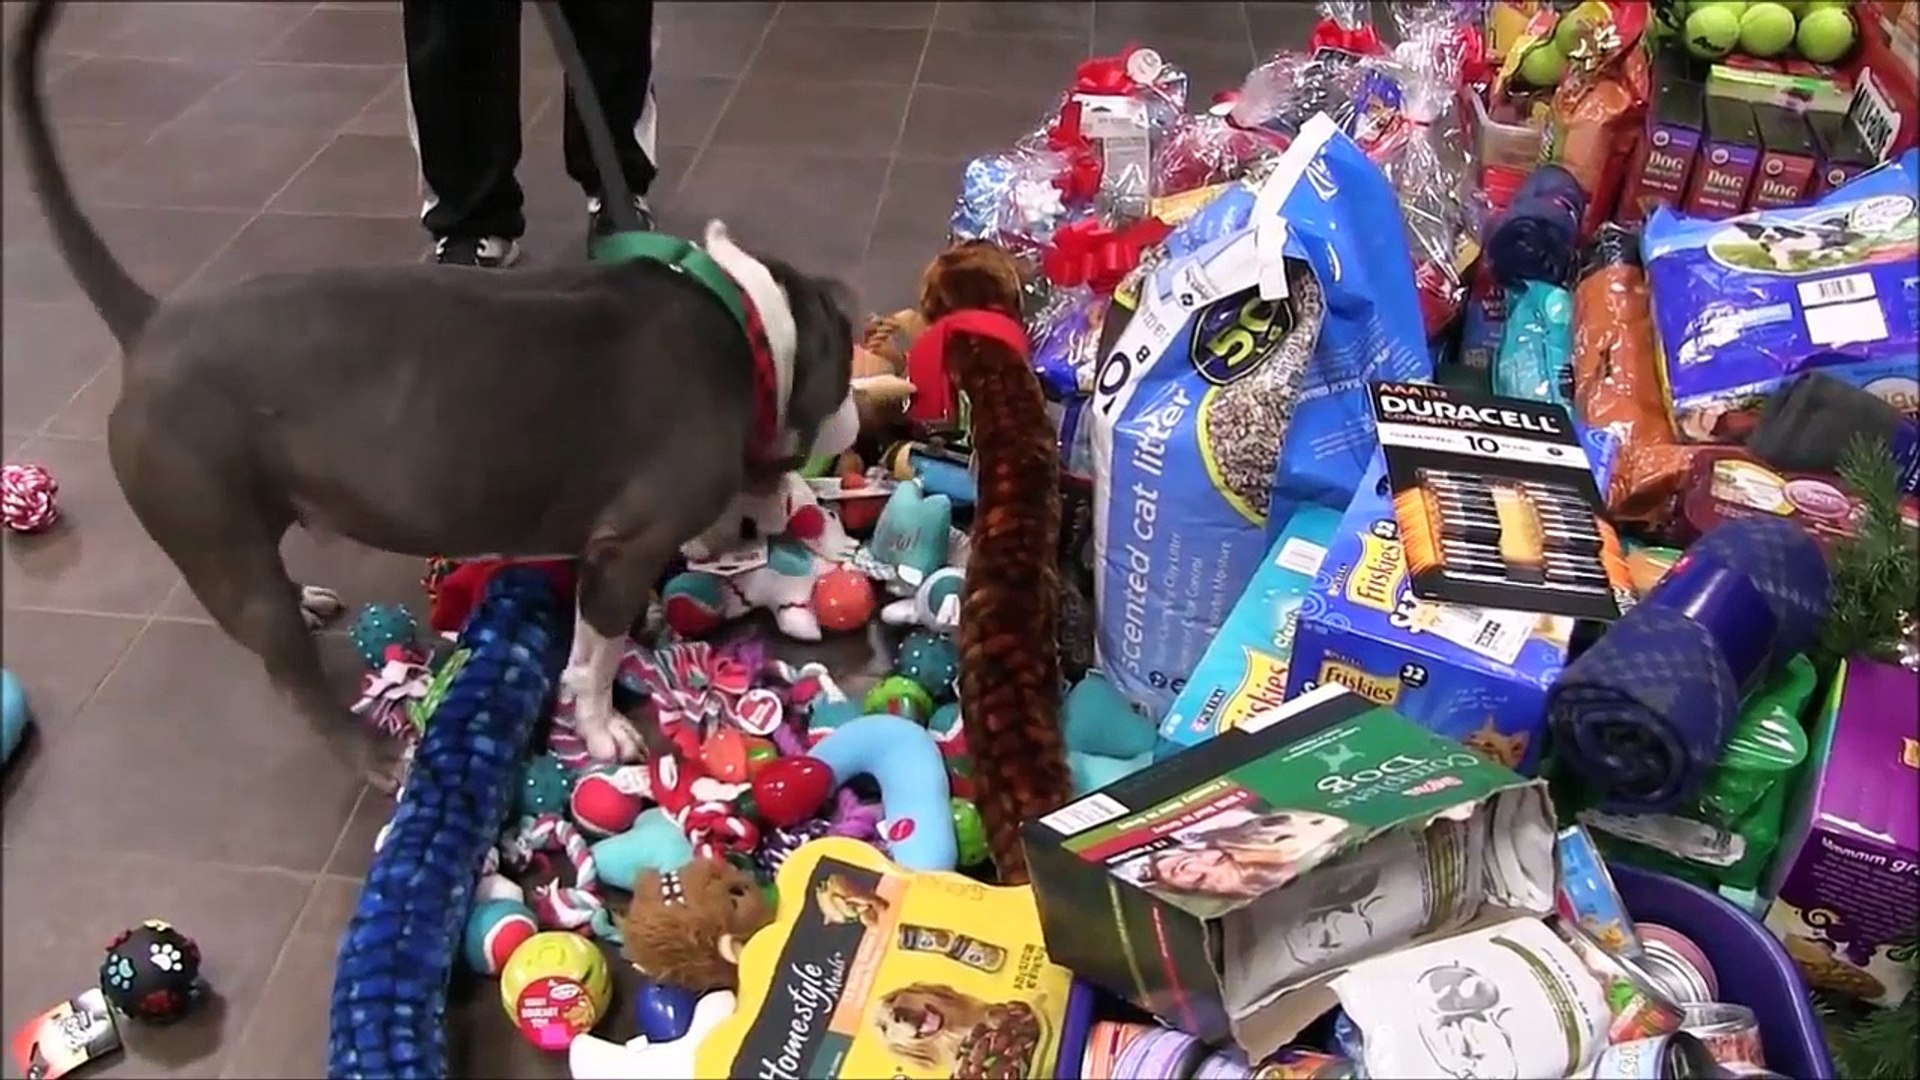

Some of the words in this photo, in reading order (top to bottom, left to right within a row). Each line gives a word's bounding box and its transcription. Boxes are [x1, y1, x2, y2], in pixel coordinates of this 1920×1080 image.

[1707, 170, 1743, 188] DOG
[1763, 180, 1798, 198] DOG
[1132, 388, 1191, 476] litter
[1381, 396, 1561, 433] DURACELL
[1465, 435, 1500, 453] 10
[1133, 483, 1159, 541] cat
[1357, 542, 1401, 604] Friskies
[1121, 546, 1154, 674] scented
[1325, 666, 1394, 700] Friskies
[1402, 663, 1425, 681] 32
[759, 962, 834, 1080] Homestyle
